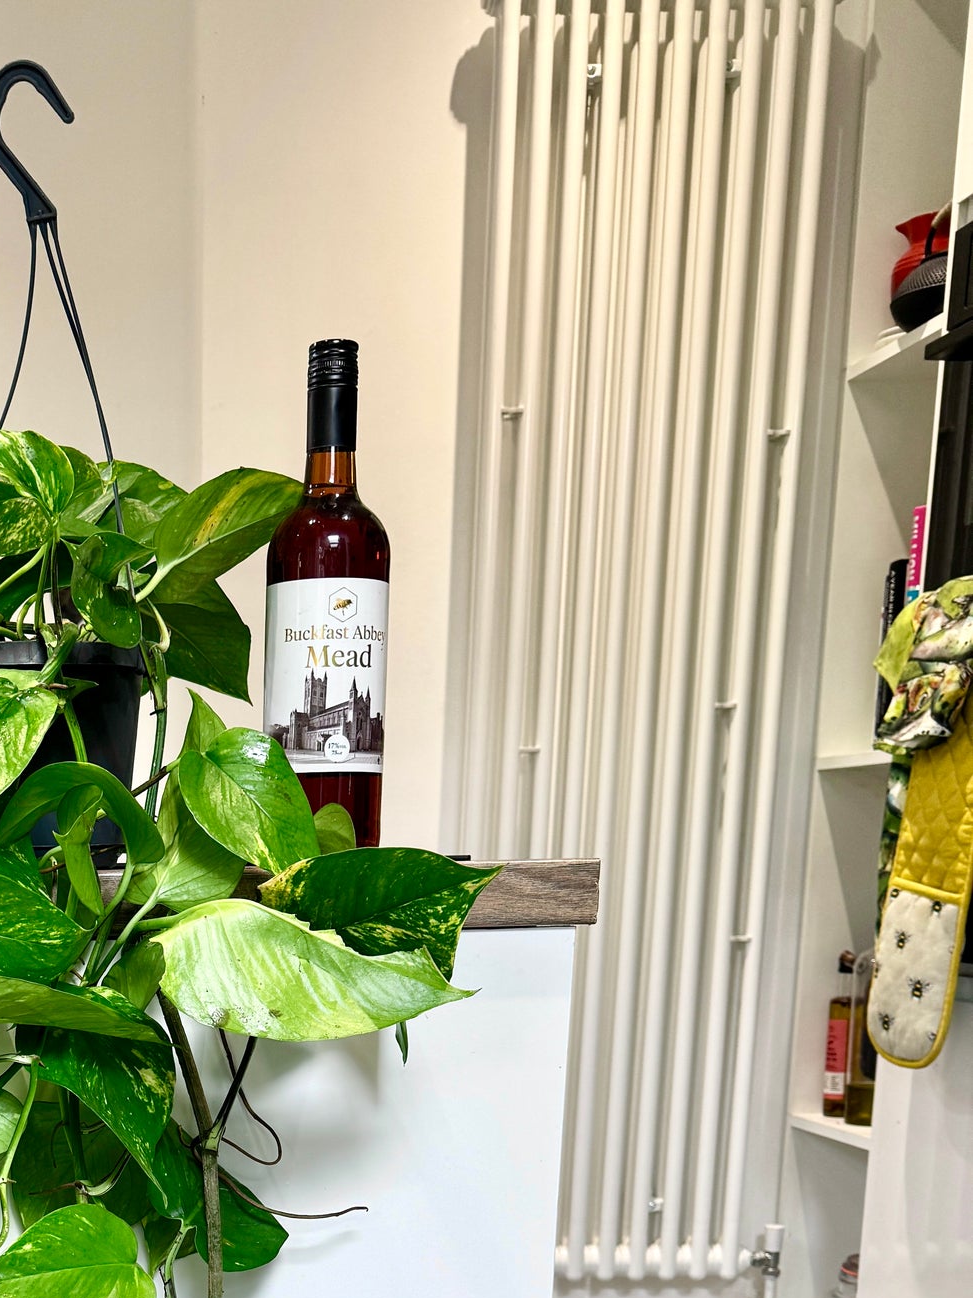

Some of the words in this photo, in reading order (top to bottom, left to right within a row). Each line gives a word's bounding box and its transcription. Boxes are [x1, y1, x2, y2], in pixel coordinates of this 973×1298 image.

[284, 624, 349, 643] Buckfast
[352, 625, 386, 645] Abbey
[305, 643, 372, 669] Mead
